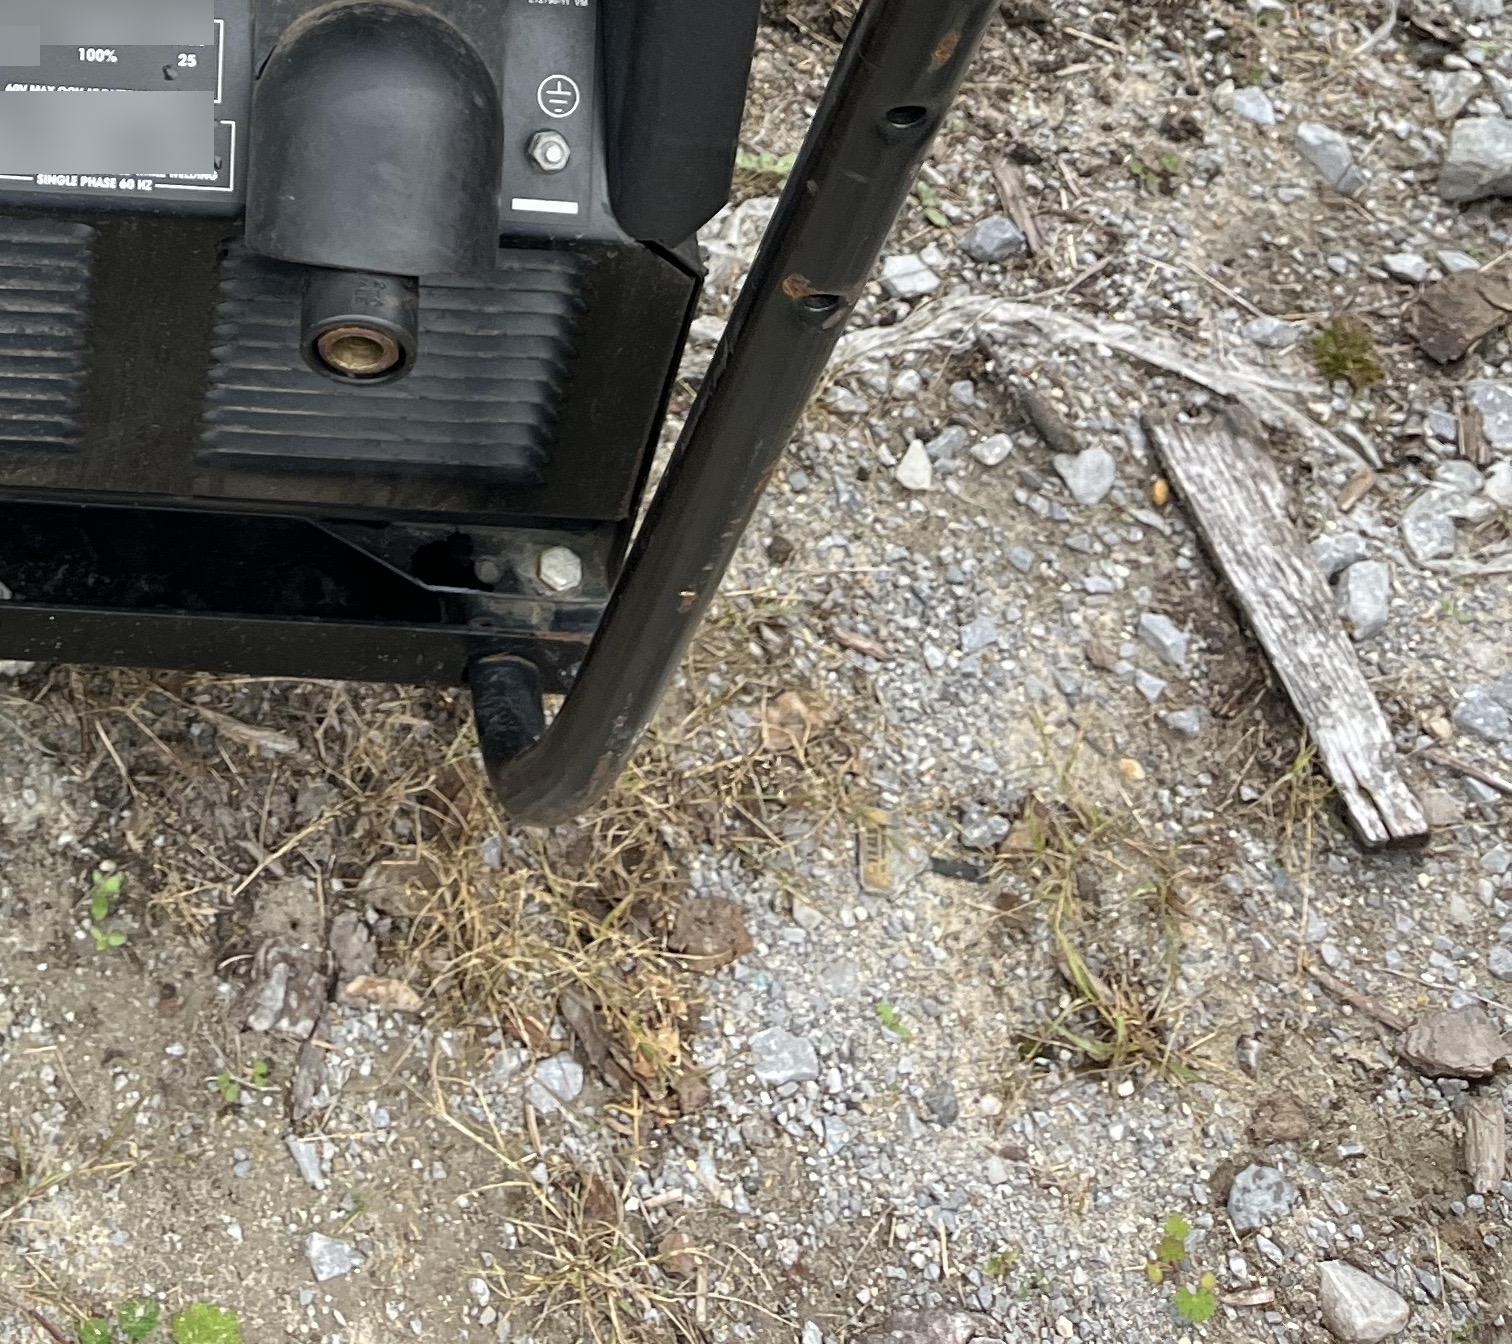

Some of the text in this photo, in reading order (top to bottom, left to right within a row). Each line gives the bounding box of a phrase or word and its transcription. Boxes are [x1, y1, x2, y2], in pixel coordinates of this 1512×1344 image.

[78, 48, 118, 63] 100%
[177, 54, 197, 67] 25
[37, 174, 77, 187] SINGLE
[80, 175, 116, 189] PHASE
[119, 178, 136, 189] 60
[137, 179, 153, 191] HZ
